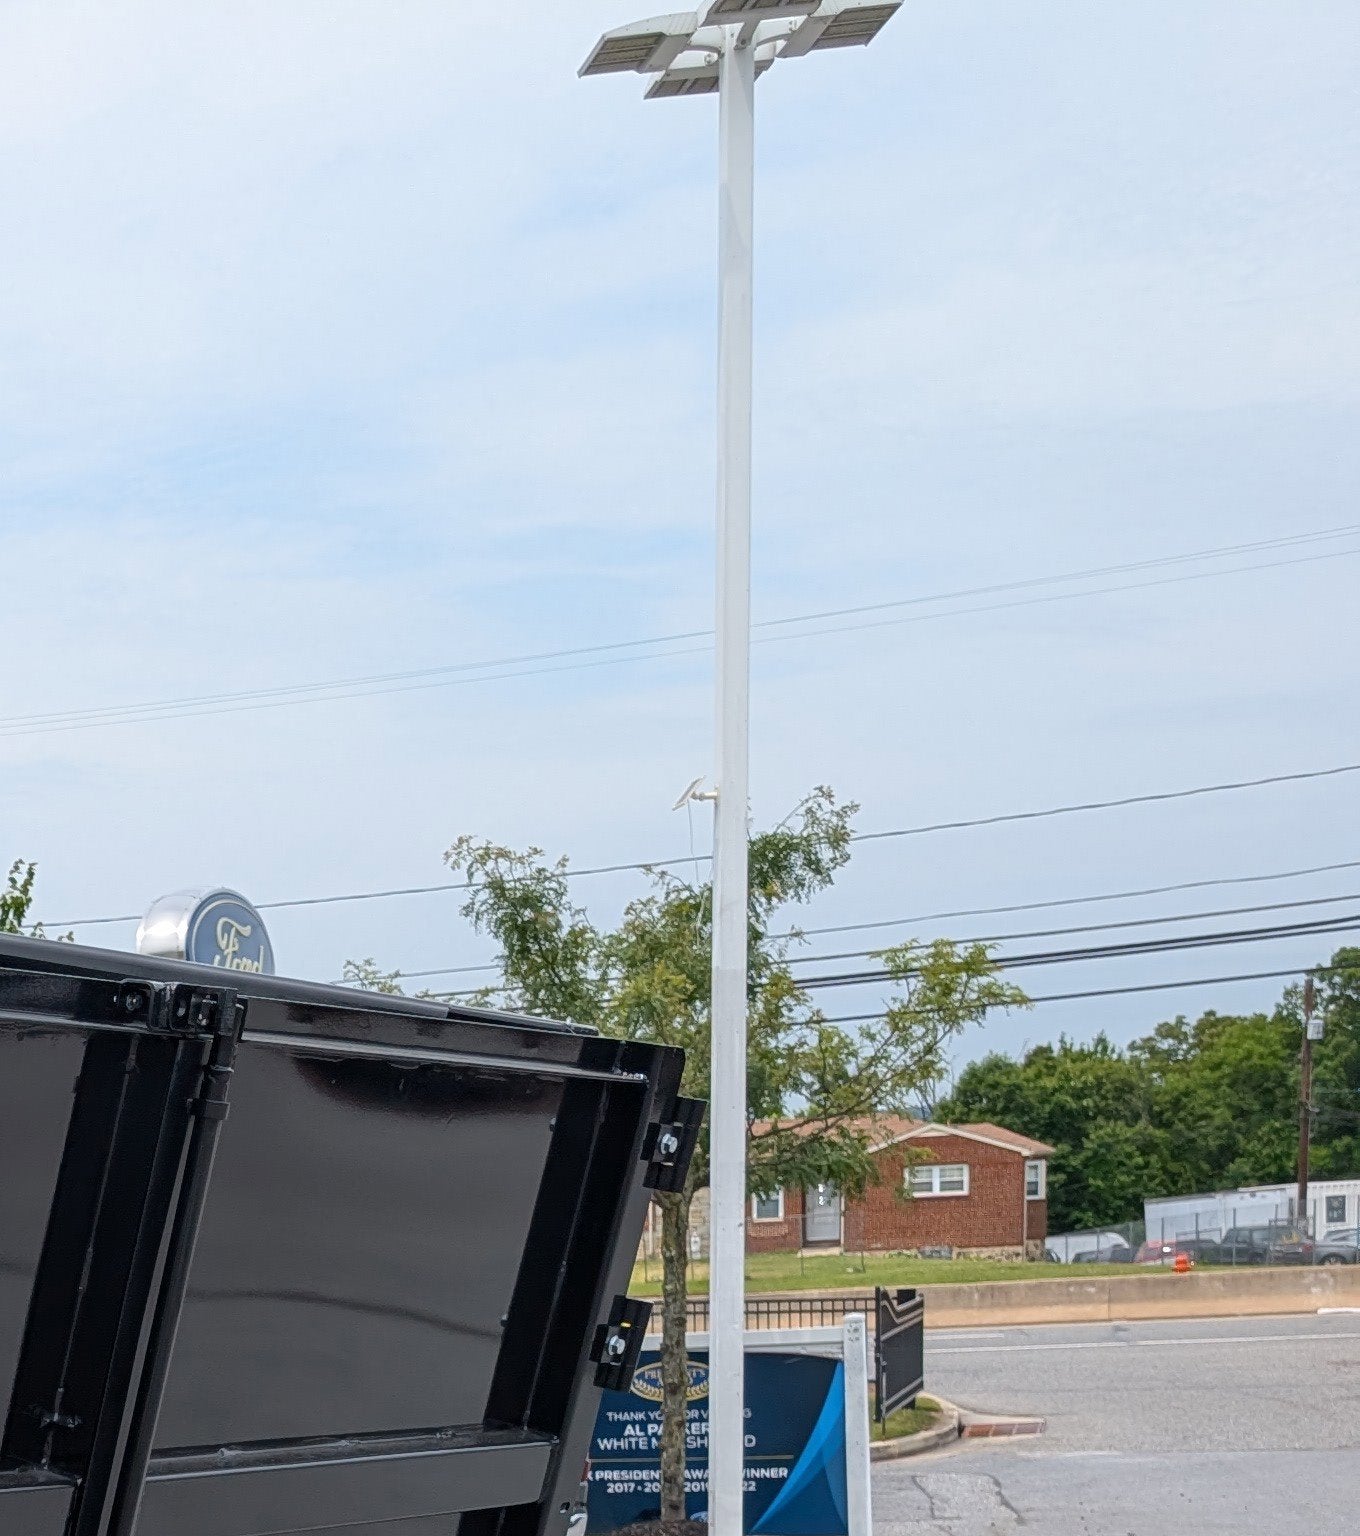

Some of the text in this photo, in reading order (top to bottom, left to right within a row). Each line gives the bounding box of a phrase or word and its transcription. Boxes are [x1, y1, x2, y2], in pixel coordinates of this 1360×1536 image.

[606, 1411, 647, 1421] THANK
[623, 1421, 709, 1436] AL PAKER
[597, 1436, 709, 1450] WHITE MSH
[595, 1469, 662, 1481] PRESIDEN
[744, 1467, 788, 1479] INNER
[606, 1482, 632, 1494] 2017
